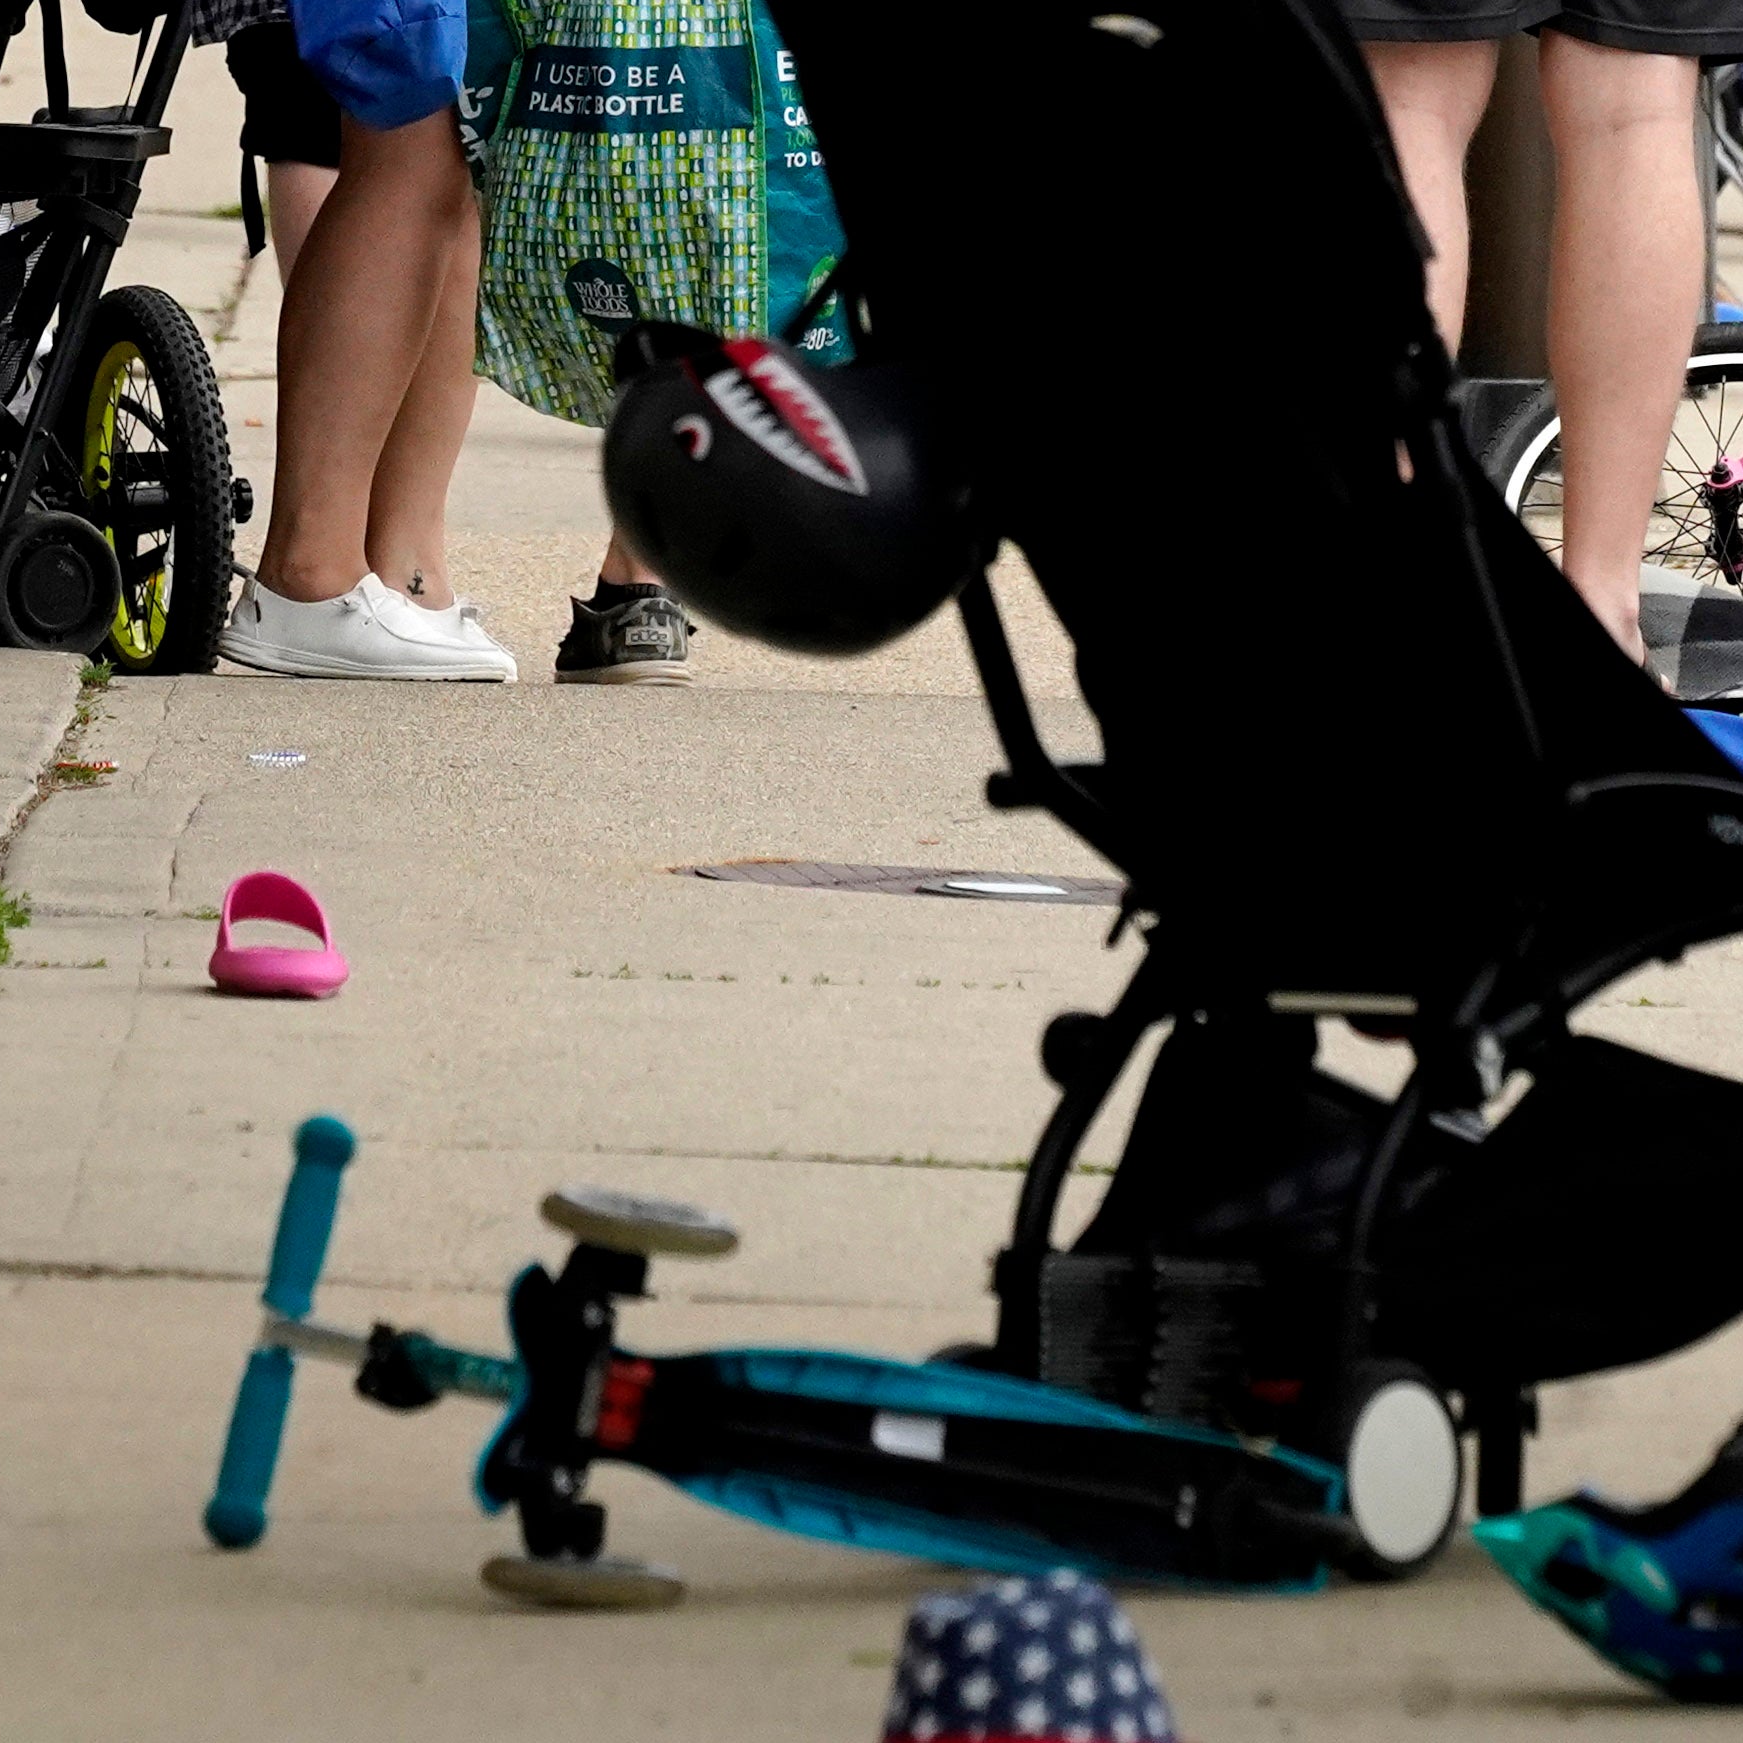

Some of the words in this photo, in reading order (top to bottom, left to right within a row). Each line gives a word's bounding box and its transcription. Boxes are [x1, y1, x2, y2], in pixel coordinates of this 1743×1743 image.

[535, 62, 542, 82] I
[593, 64, 616, 87] TO
[627, 65, 659, 88] BE
[667, 63, 686, 85] A
[594, 93, 685, 117] BOTTLE
[784, 106, 811, 127] CA
[784, 151, 808, 168] TO
[573, 281, 629, 298] WHOLE
